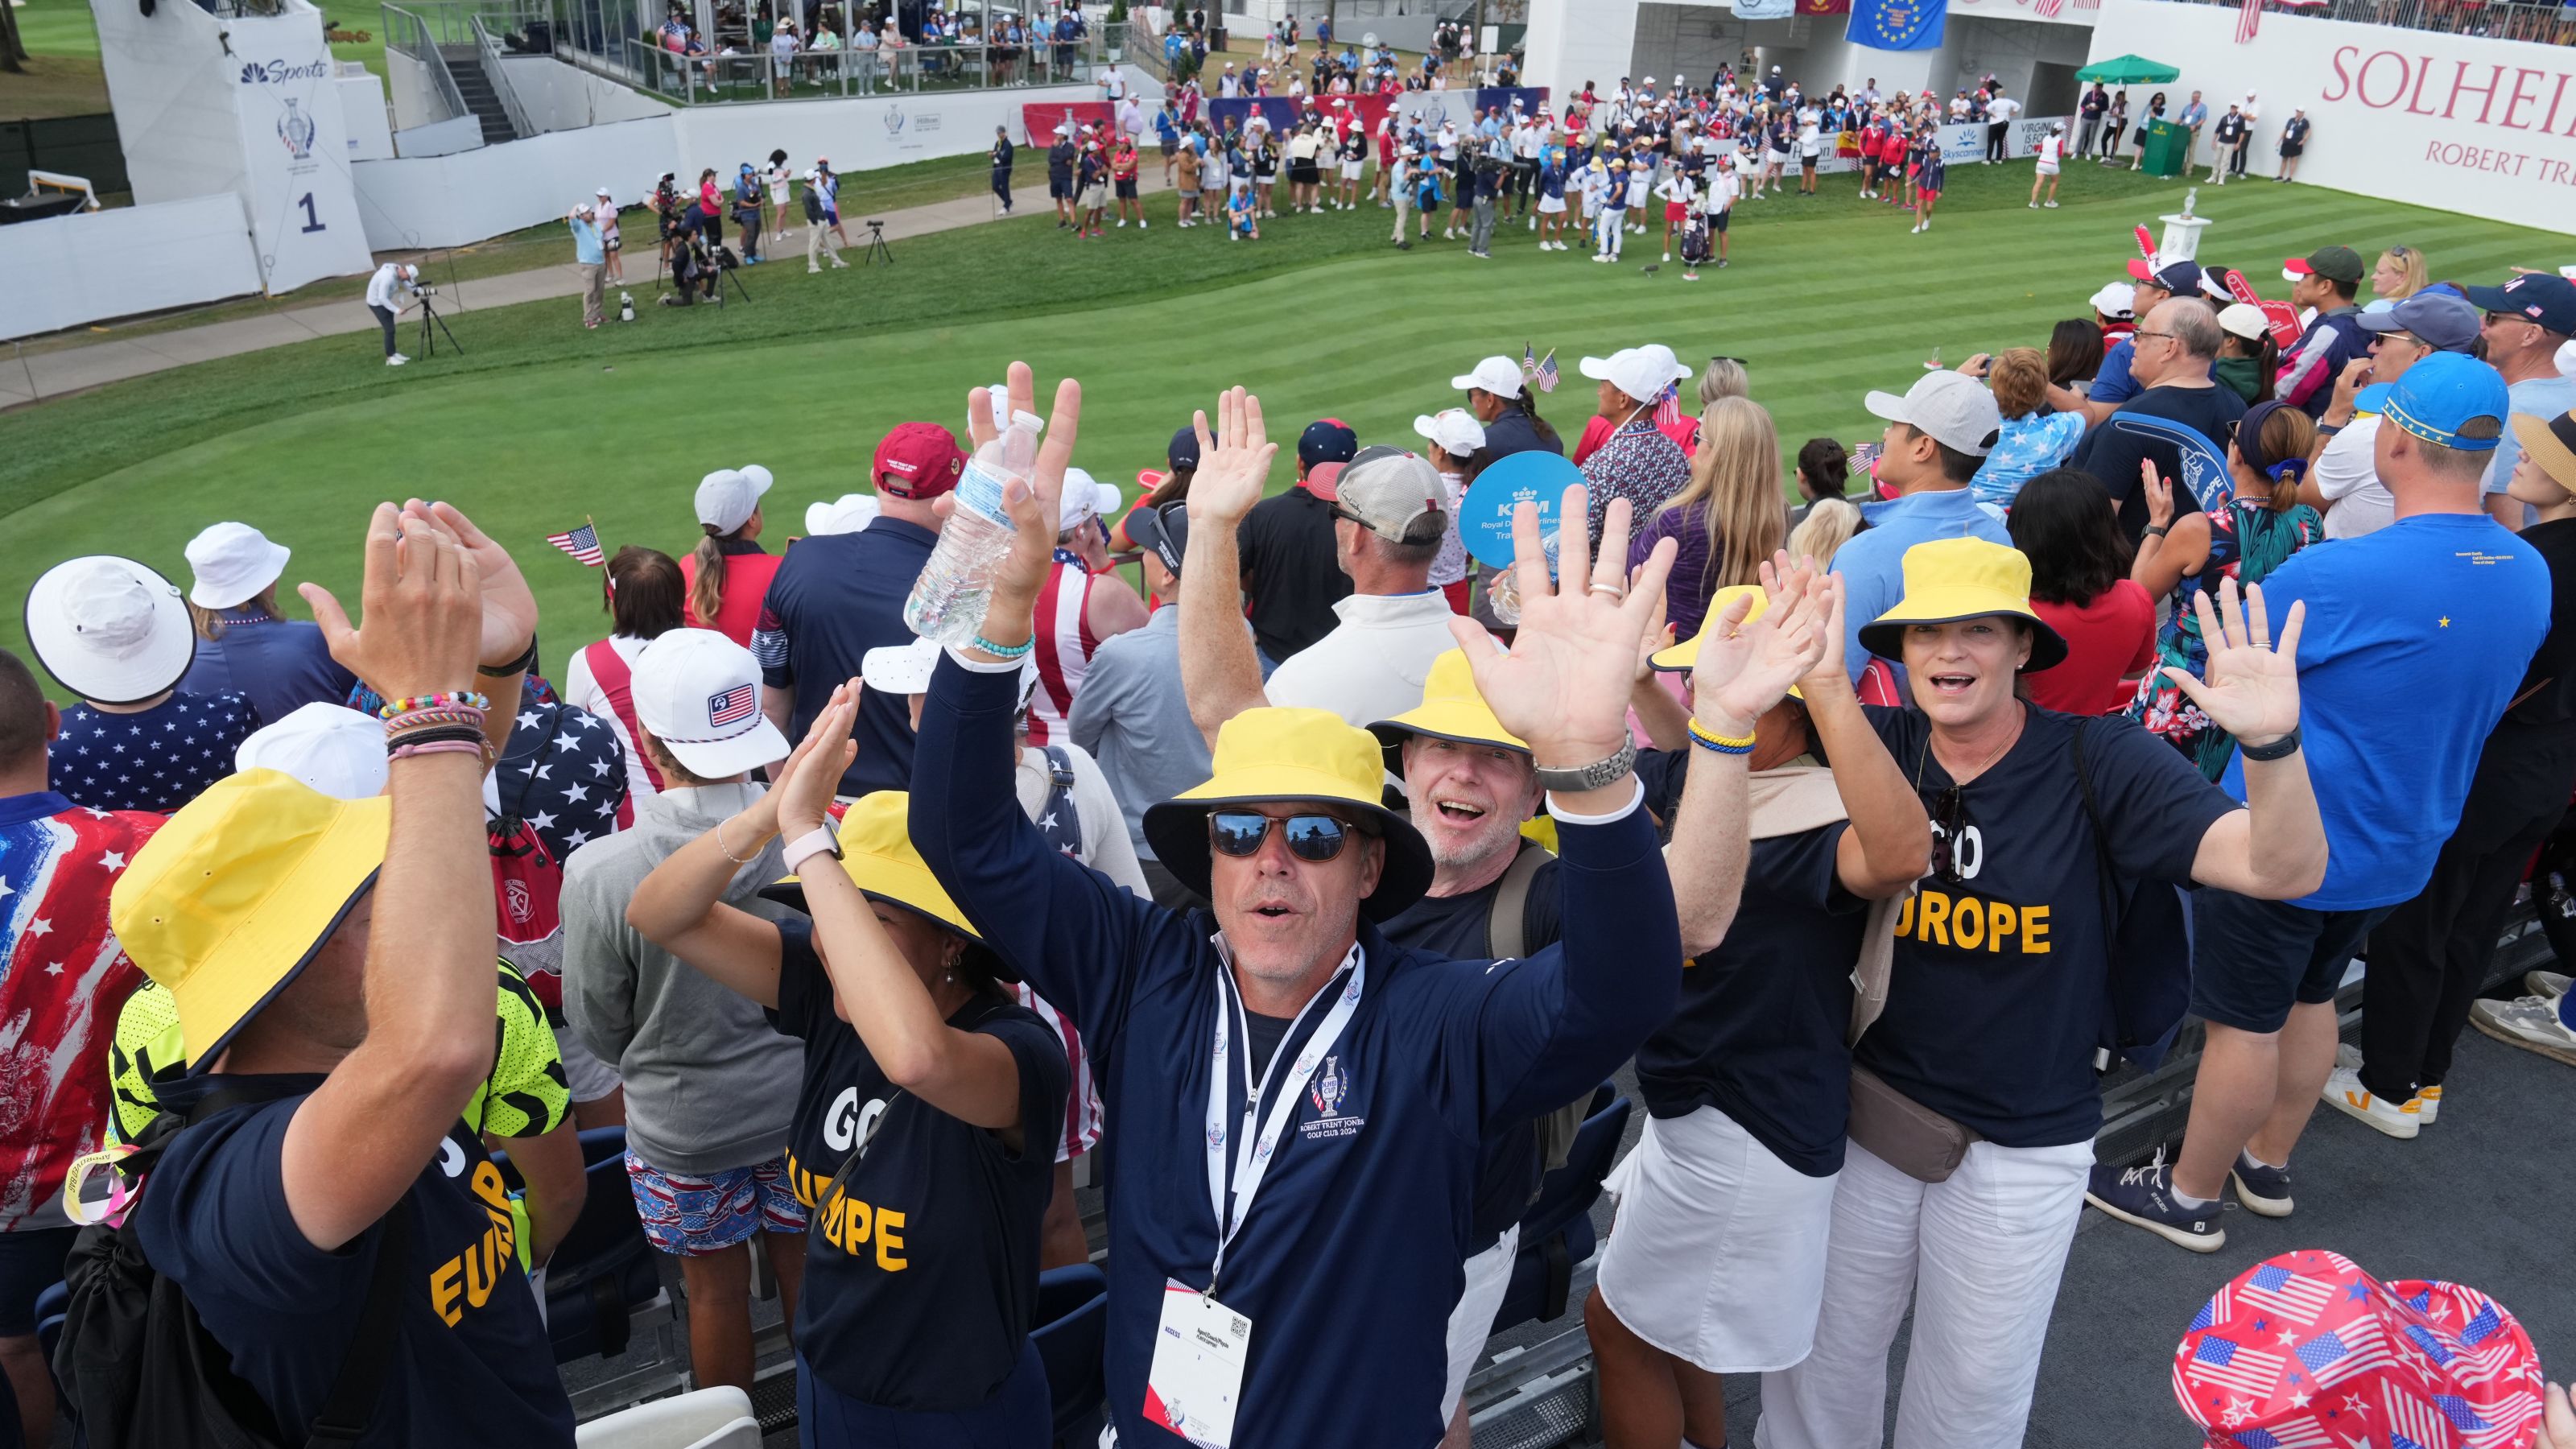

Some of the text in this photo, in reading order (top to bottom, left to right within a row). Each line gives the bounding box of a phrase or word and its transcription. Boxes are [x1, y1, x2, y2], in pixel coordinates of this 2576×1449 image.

[266, 59, 327, 86] Sports
[2025, 134, 2031, 144] IS
[1793, 147, 1831, 159] Hon
[1942, 147, 1986, 161] Skyscanner
[2425, 140, 2530, 176] ROBERT
[298, 192, 326, 234] 1
[1497, 500, 1550, 517] KM
[1481, 520, 1504, 530] Royal
[1538, 517, 1562, 525] rlines
[1893, 890, 2050, 954] UROPE
[1300, 1118, 1364, 1132] ROBERT TRENT JONES
[1307, 1127, 1356, 1139] GOLF CLUB 2024
[785, 1146, 908, 1272] UROPE
[2194, 1221, 2206, 1232] FJ
[1164, 1326, 1181, 1339] ACCESS
